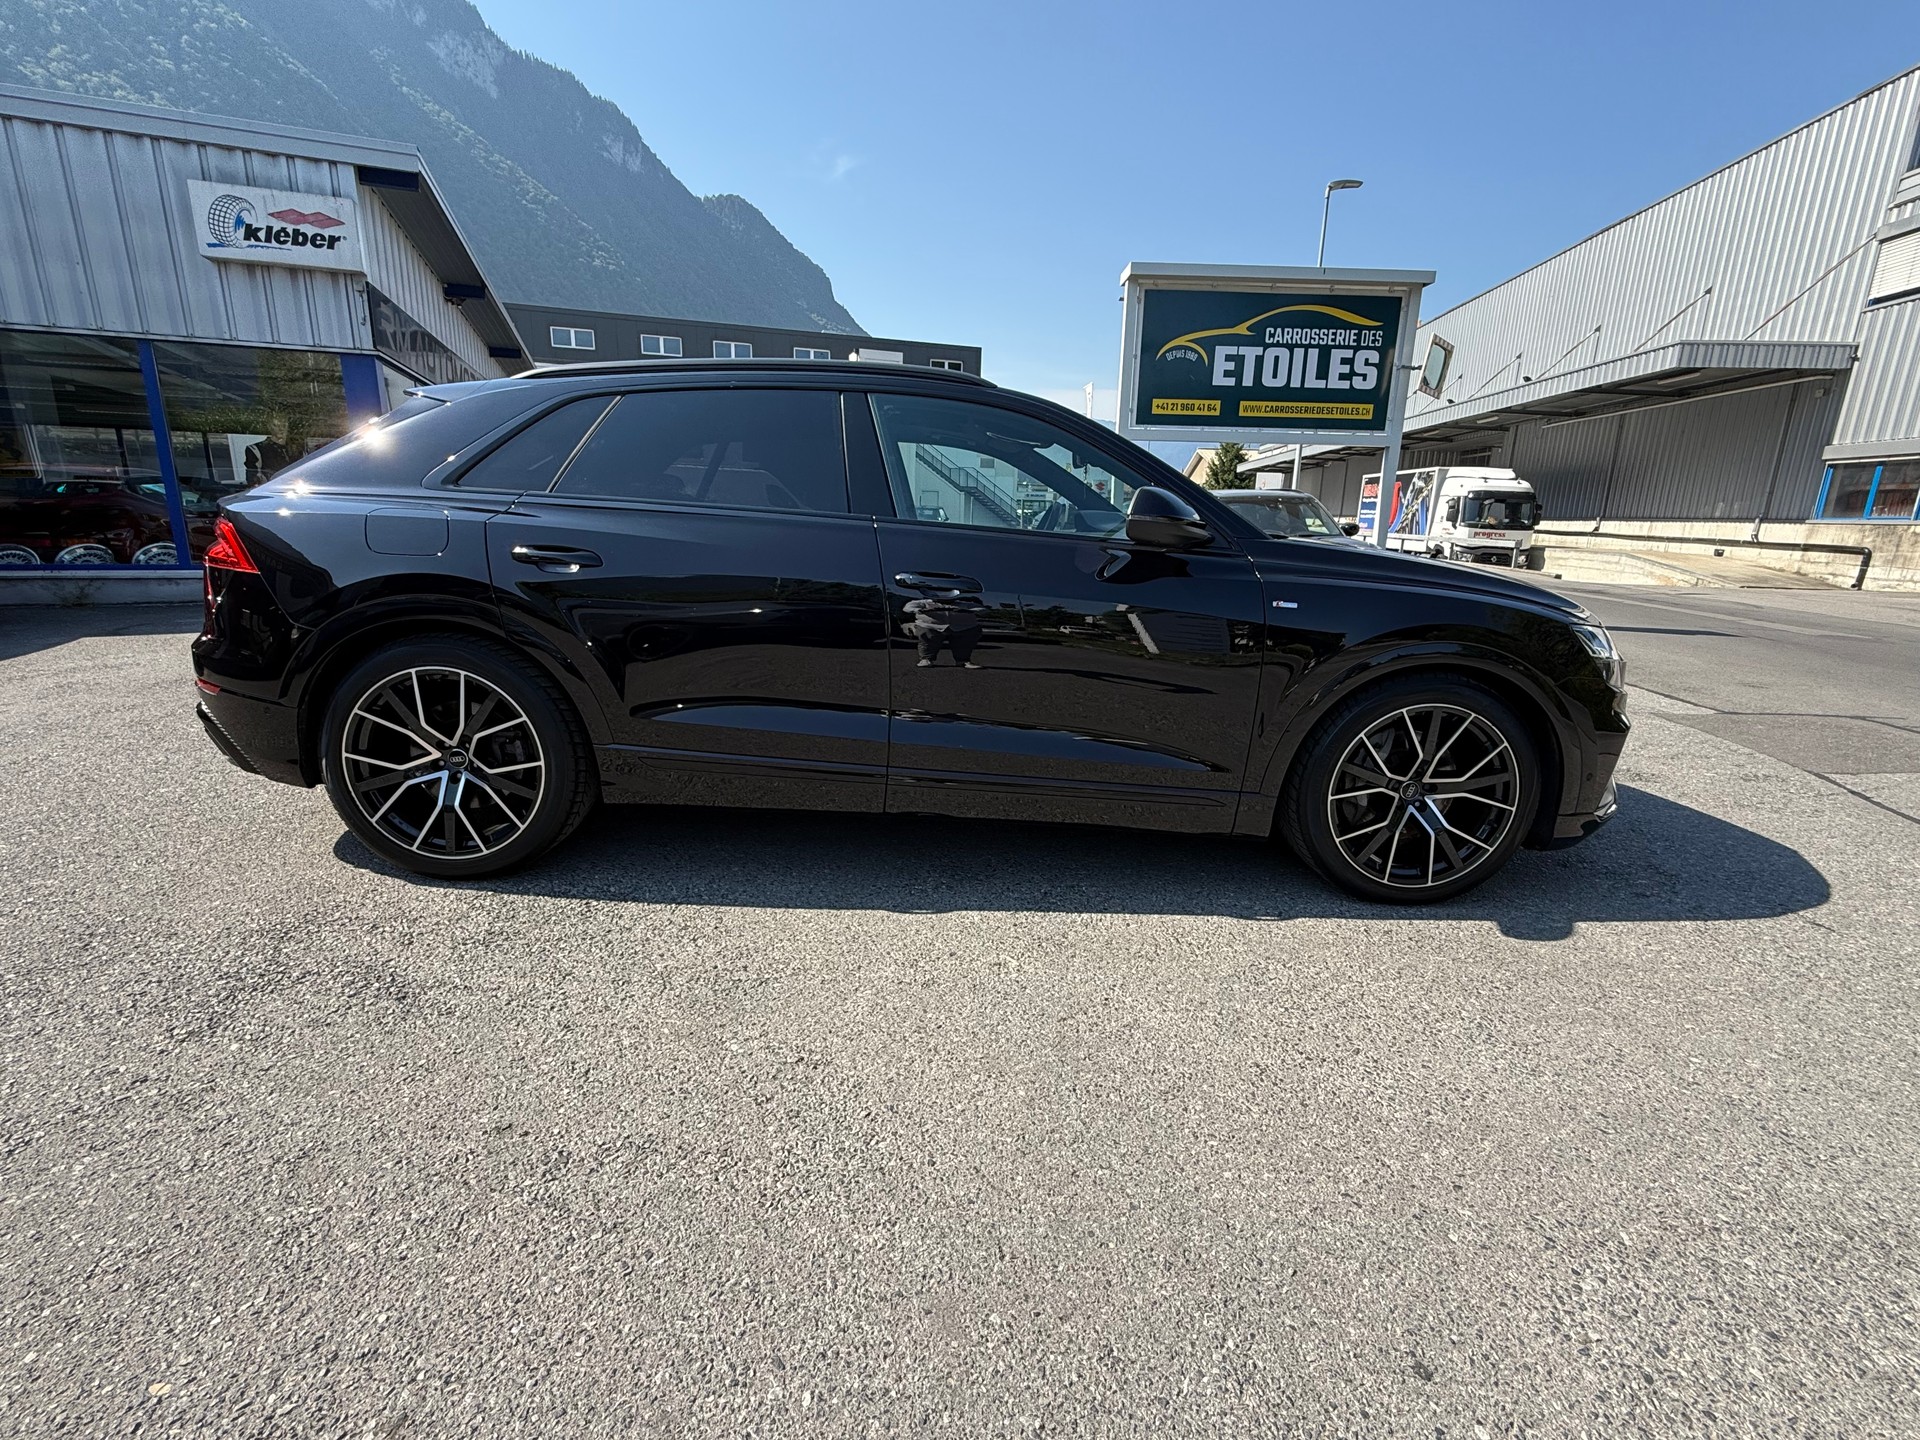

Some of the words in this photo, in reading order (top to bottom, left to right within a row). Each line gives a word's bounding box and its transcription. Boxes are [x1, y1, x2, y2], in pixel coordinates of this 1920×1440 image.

[243, 223, 341, 250] kléber
[1265, 327, 1358, 346] CARROSSERIE
[1360, 330, 1383, 347] DES
[1165, 349, 1185, 361] DEPUIS
[1212, 345, 1380, 390] ETOILES
[1155, 403, 1169, 411] +41
[1170, 403, 1178, 411] 21
[1180, 403, 1195, 412] 960
[1197, 403, 1206, 412] 41
[1207, 404, 1217, 412] 64
[1242, 404, 1371, 416] WWW.CARROSSERIEDESETOILES.CH
